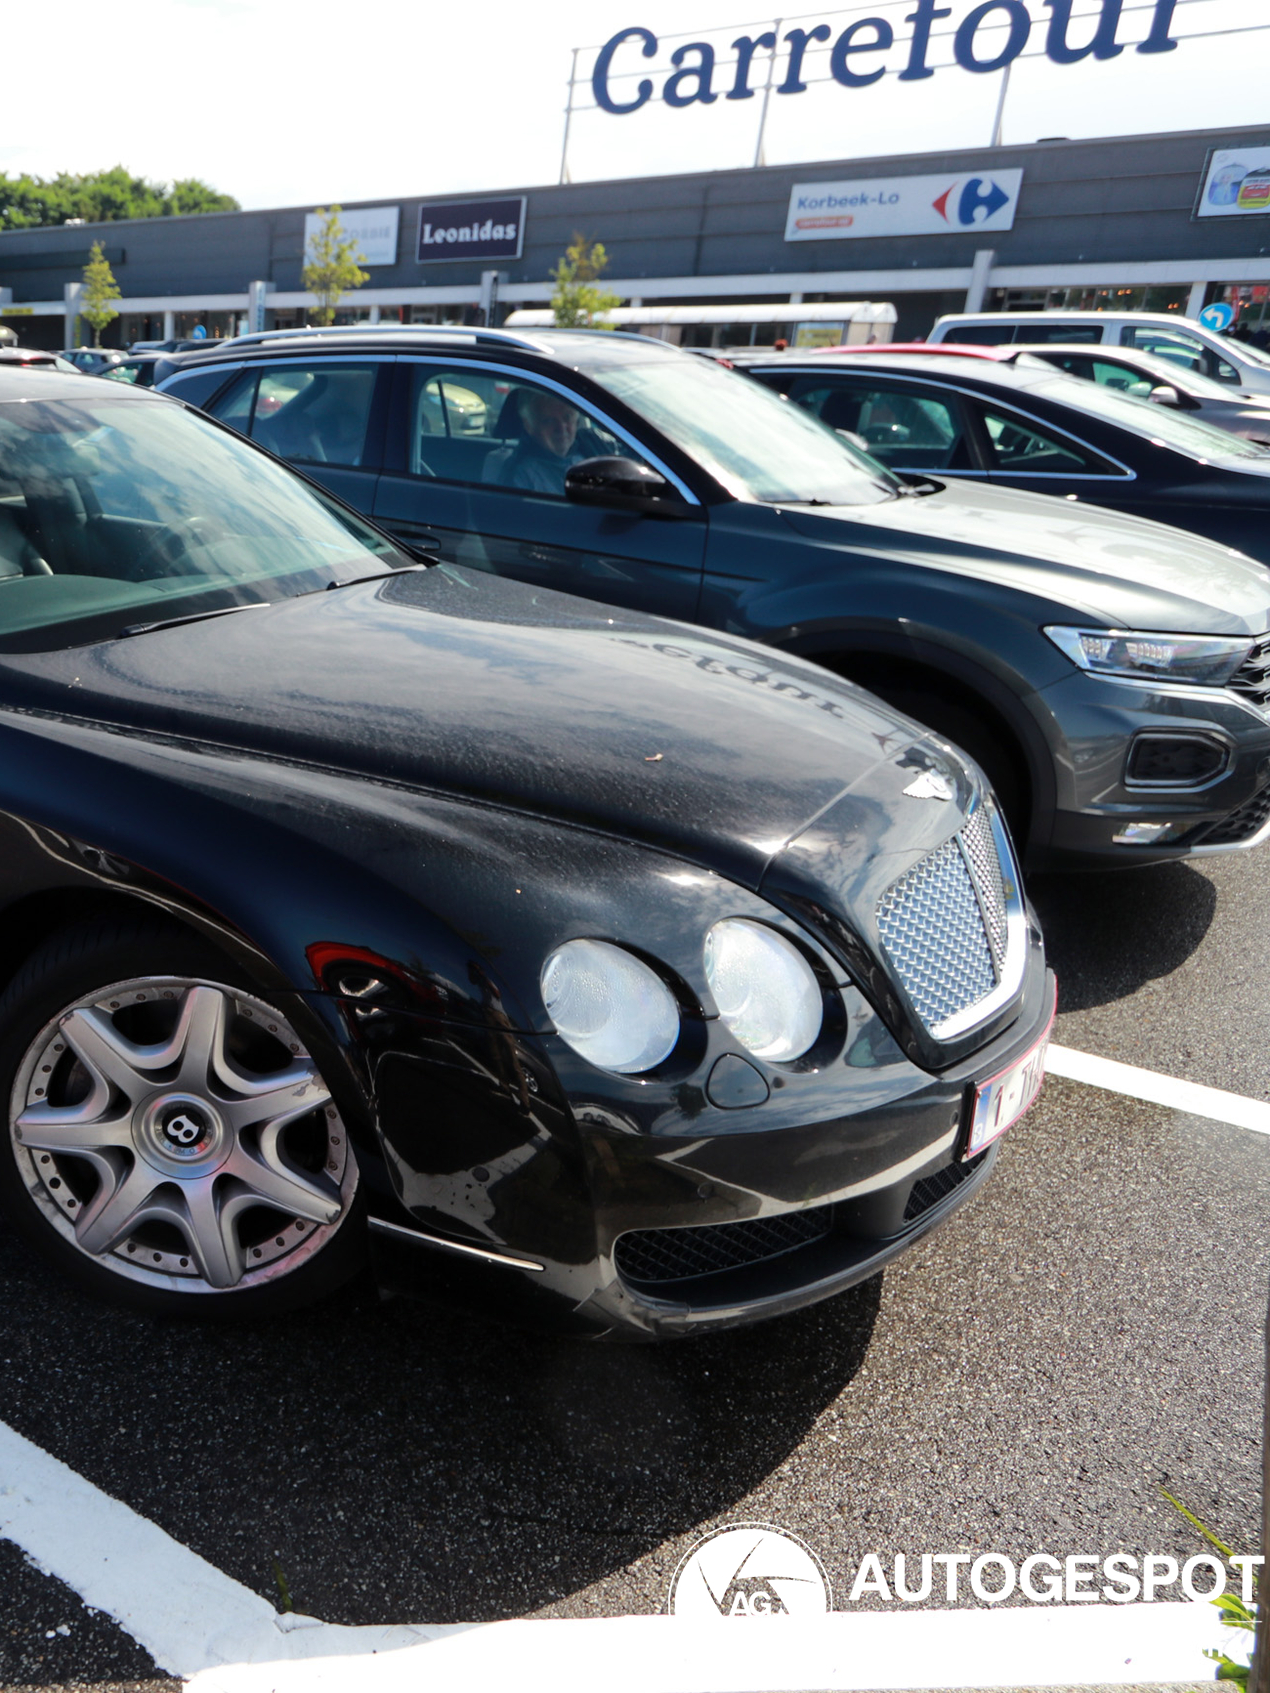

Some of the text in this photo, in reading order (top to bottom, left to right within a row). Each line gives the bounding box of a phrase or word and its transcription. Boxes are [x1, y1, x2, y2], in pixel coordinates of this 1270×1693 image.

[592, 0, 1178, 115] Carrefour
[797, 192, 900, 210] Korbeek-Lo
[422, 218, 517, 244] Leonidas
